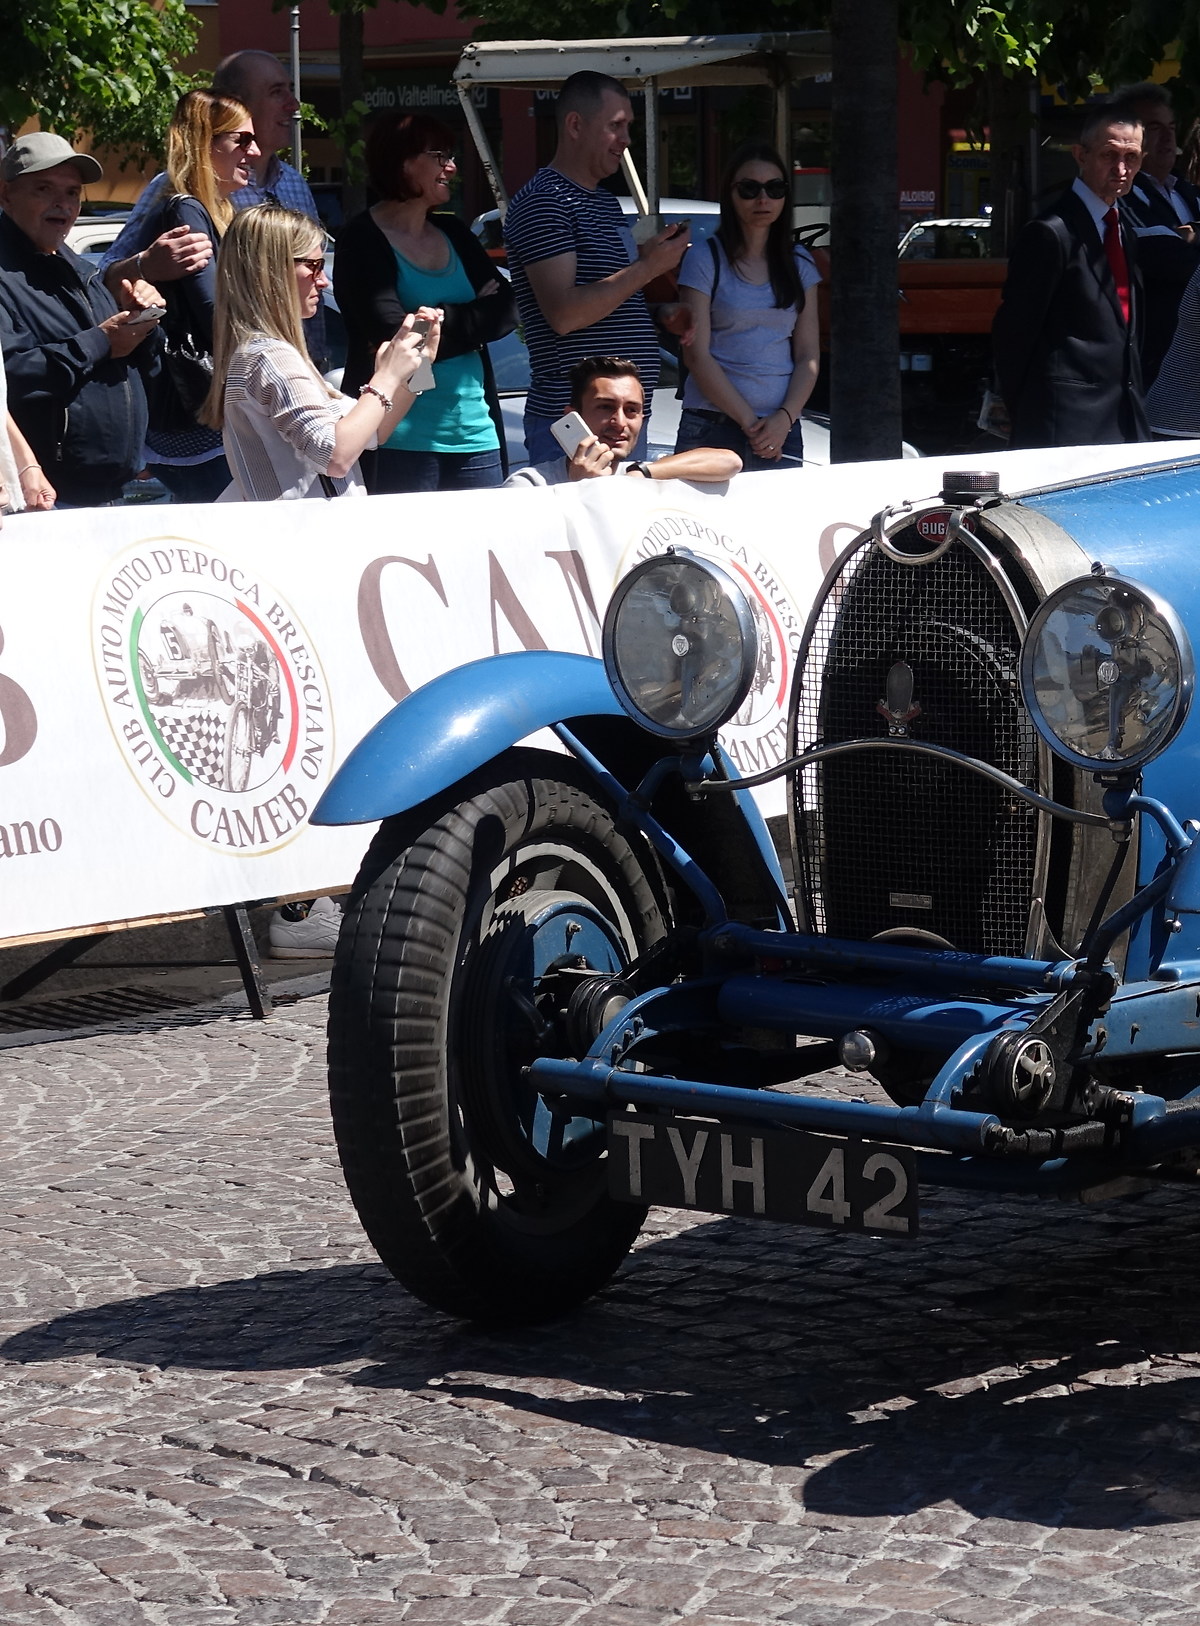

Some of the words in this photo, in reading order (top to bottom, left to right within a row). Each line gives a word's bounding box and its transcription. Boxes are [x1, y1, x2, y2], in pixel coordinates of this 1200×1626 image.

[397, 84, 459, 107] Valtellines
[899, 190, 936, 203] ALOISIO
[664, 517, 756, 564] D'EPOCA
[102, 557, 152, 623] MOTO
[150, 548, 260, 606] D'EPOCA
[101, 624, 135, 709] AUTO
[265, 601, 324, 780] BRESCIANO
[122, 719, 176, 798] CLUB
[190, 783, 308, 849] CAMEB
[612, 1120, 766, 1214] TYH
[806, 1148, 910, 1232] 42
